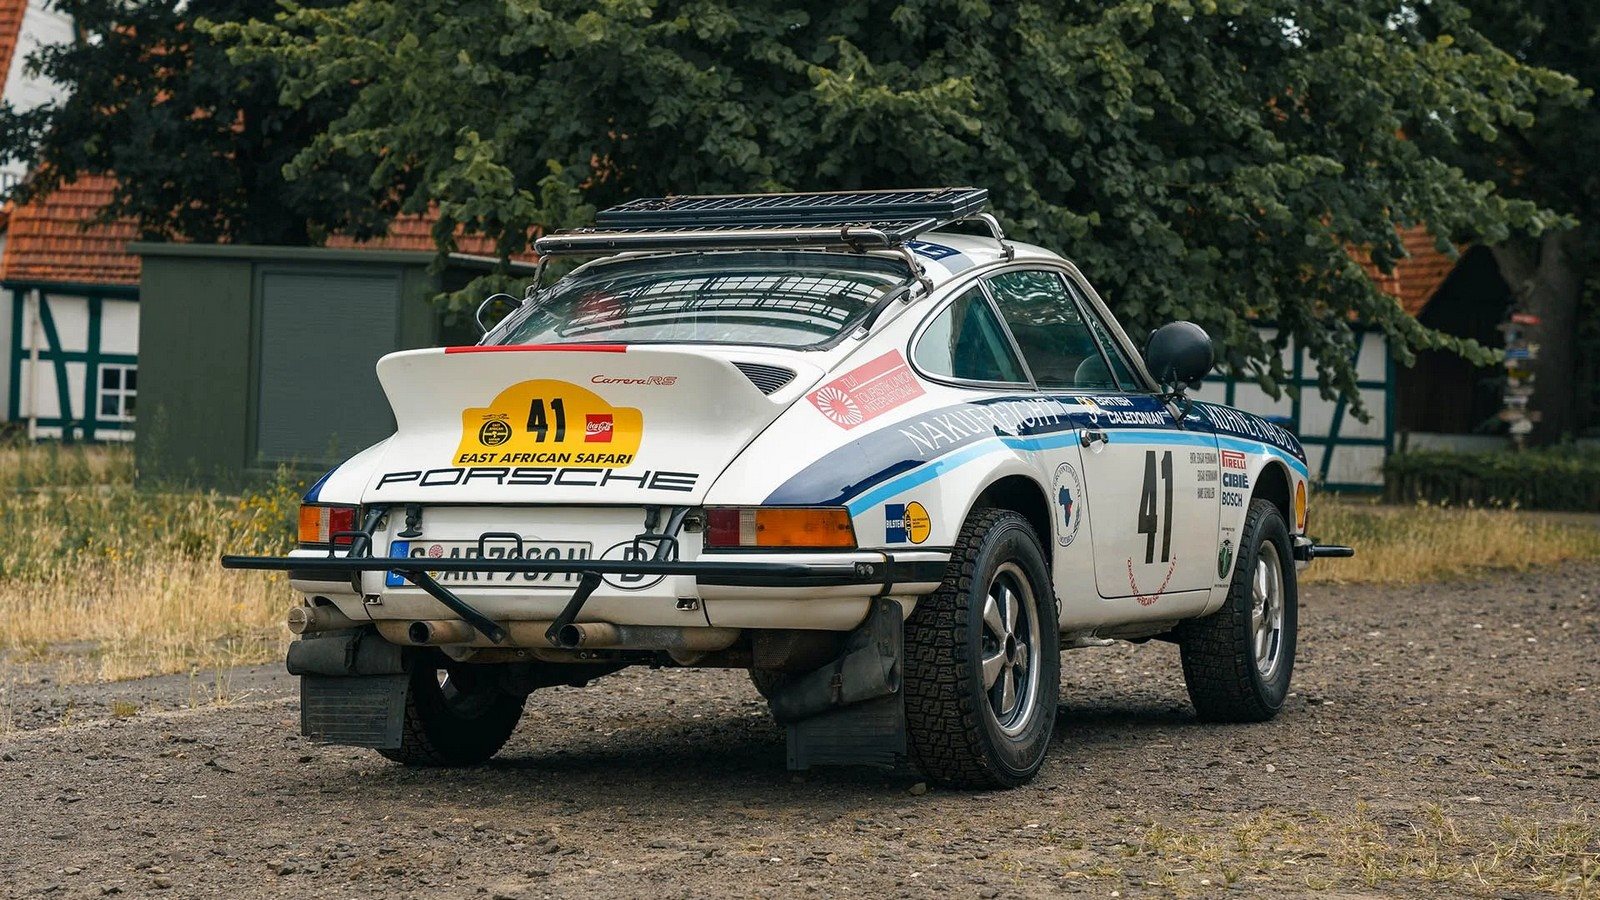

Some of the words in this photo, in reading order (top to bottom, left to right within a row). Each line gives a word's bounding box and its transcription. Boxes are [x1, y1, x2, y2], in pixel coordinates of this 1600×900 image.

[840, 374, 859, 389] TUI
[1092, 396, 1134, 407] BRITISH
[526, 398, 566, 443] 41
[1106, 411, 1165, 425] CALEDONIAN
[459, 453, 497, 464] EAST
[500, 453, 571, 464] AFRICAN
[574, 453, 633, 465] SAFARI
[1221, 450, 1246, 469] PIRELLI
[375, 467, 699, 492] PORSCHE
[1138, 450, 1173, 564] 41
[1222, 491, 1243, 507] BOSCH
